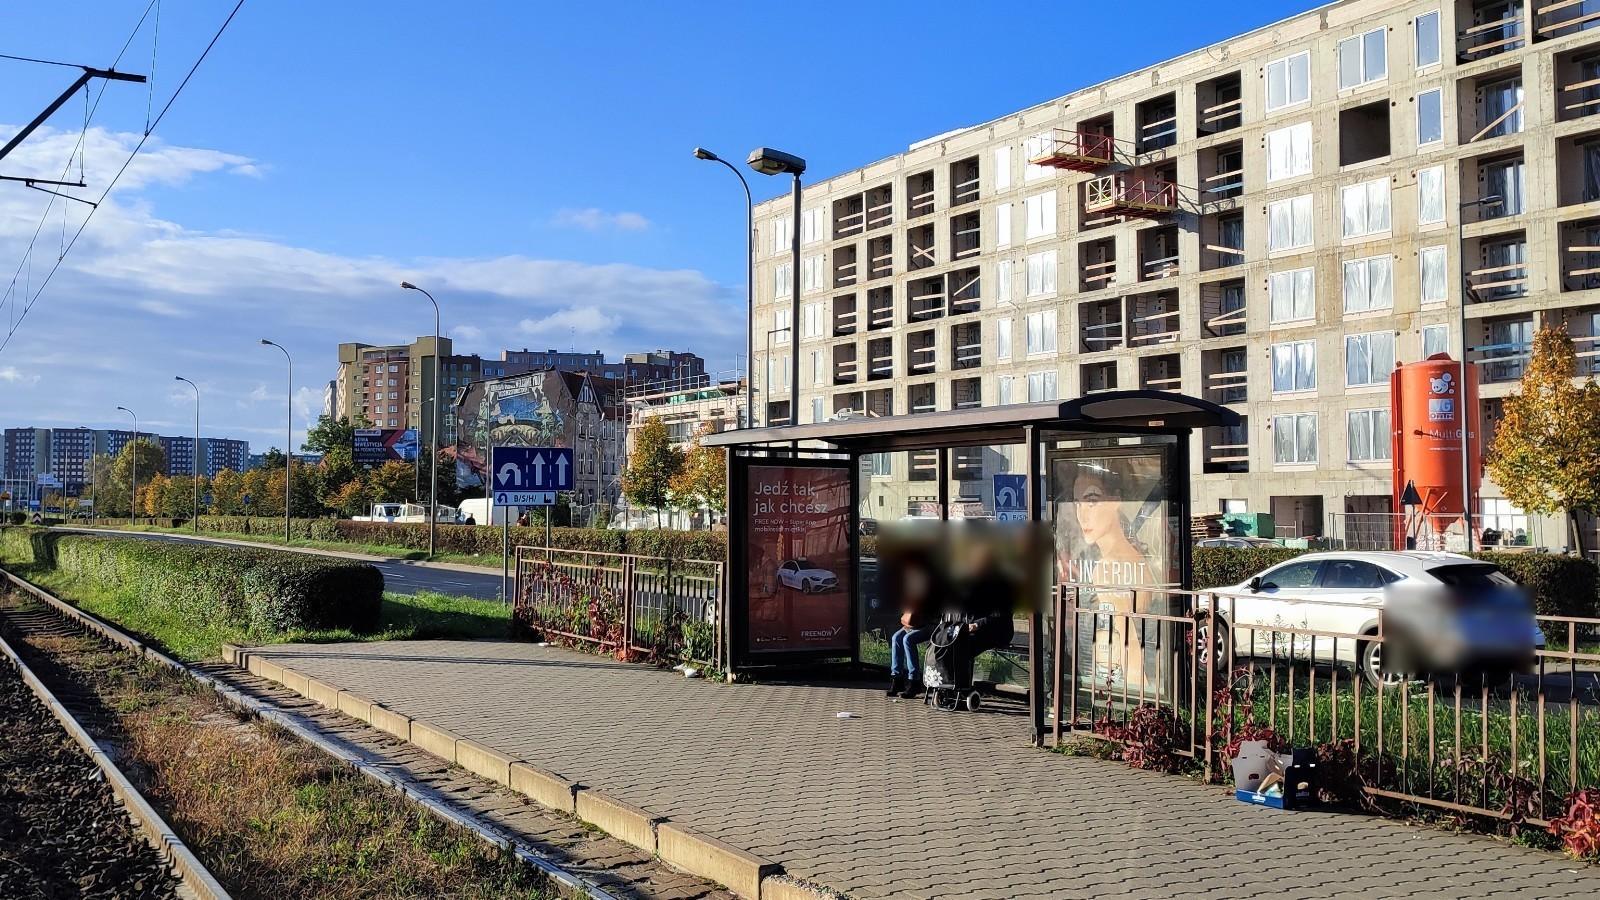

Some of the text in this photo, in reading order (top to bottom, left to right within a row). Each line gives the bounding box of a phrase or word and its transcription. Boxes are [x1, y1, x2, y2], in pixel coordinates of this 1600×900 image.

[754, 480, 819, 499] Jedź tak,
[753, 498, 829, 516] jak chcesz
[1069, 559, 1146, 585] L'INTERDIT
